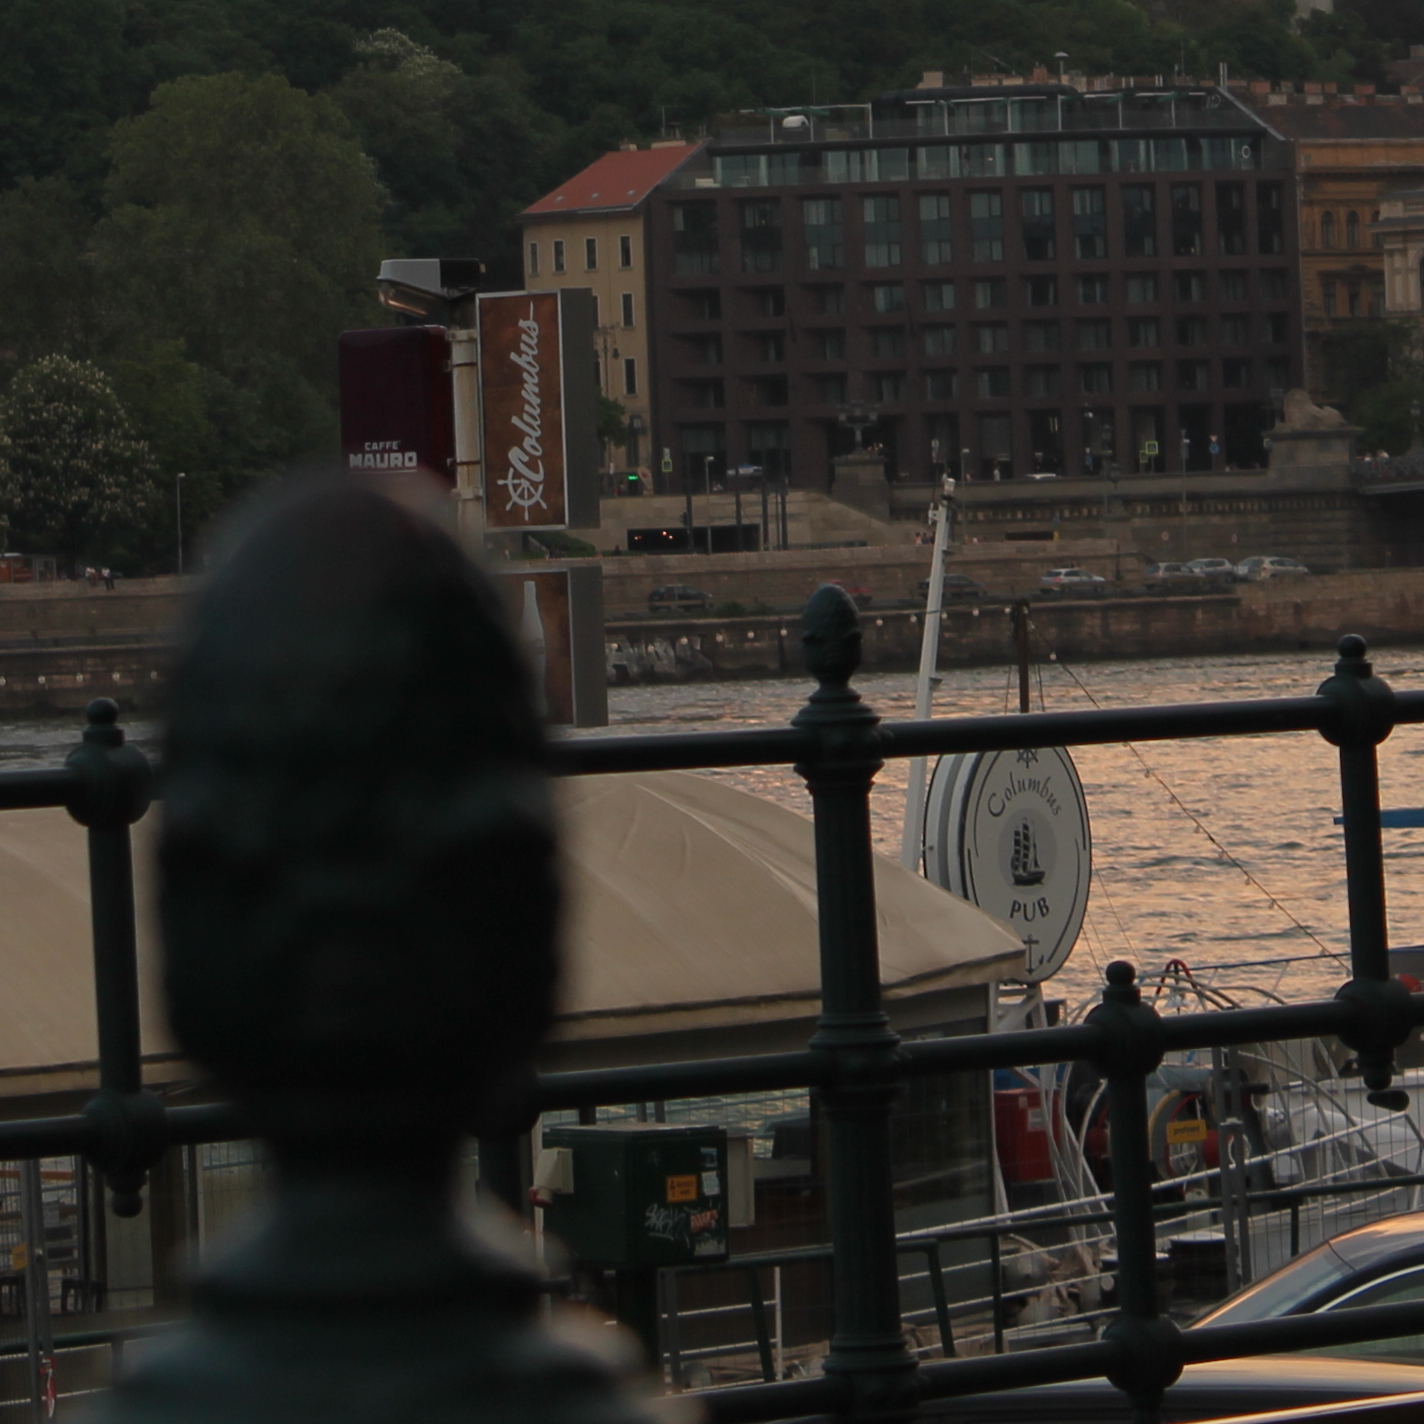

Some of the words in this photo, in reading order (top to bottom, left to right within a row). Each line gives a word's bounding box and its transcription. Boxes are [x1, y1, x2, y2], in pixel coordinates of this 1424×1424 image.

[508, 300, 544, 483] Columbus
[348, 450, 418, 469] MAURO
[987, 771, 1062, 818] Columbus
[1009, 896, 1050, 923] PUB
